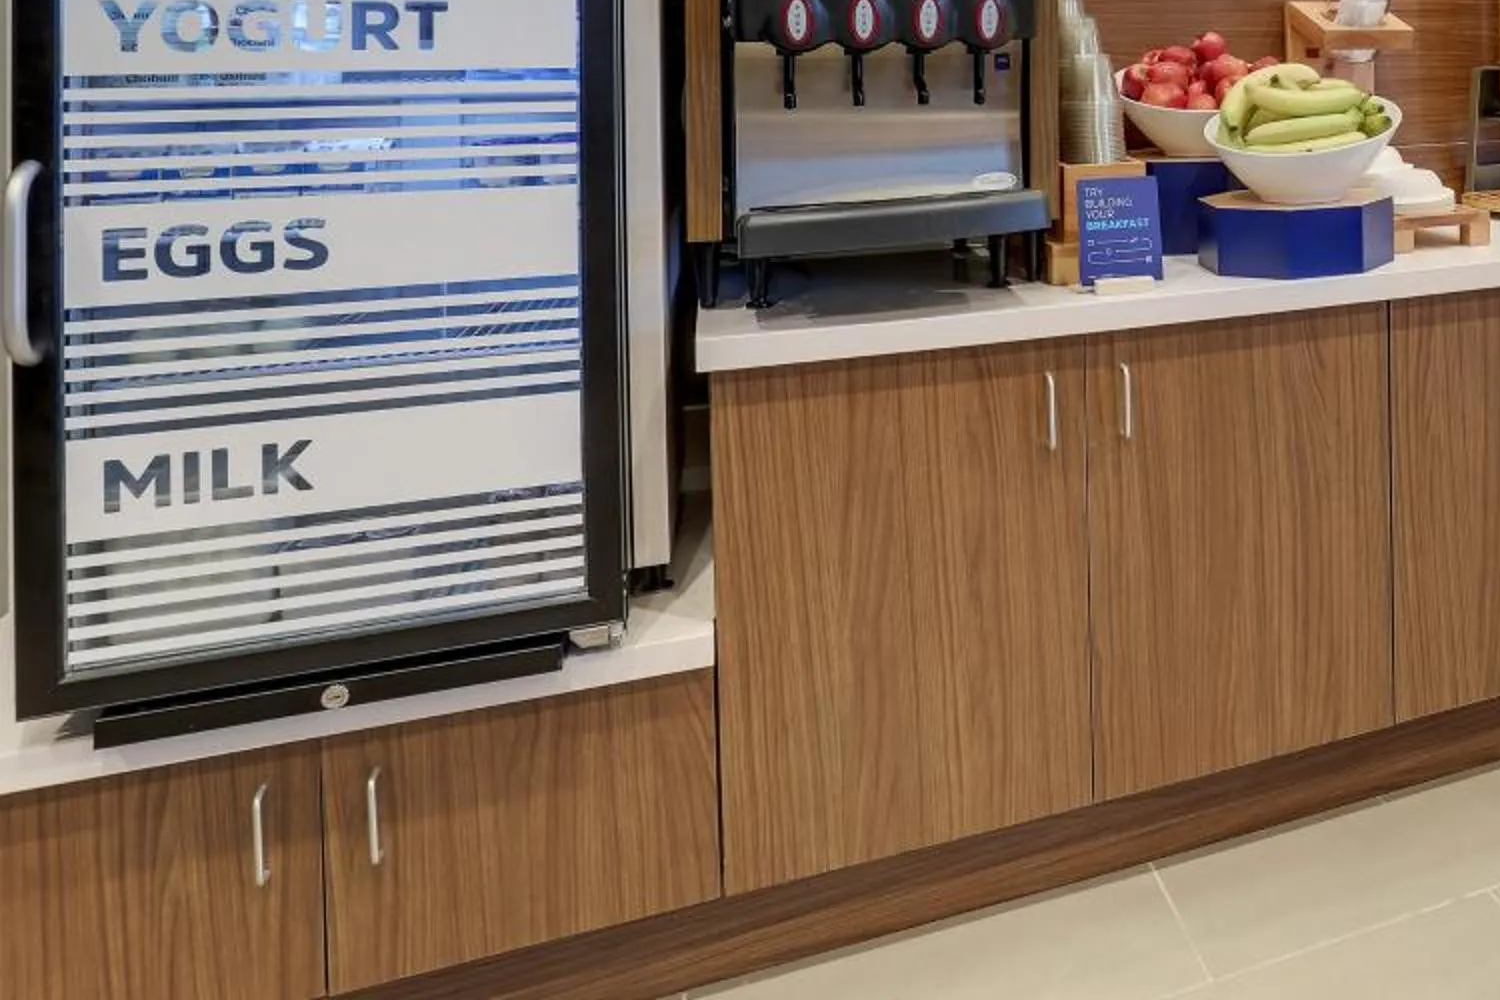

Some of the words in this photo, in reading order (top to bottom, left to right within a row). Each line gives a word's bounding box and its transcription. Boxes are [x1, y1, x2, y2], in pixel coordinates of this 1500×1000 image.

[99, 0, 449, 53] YOGURT
[1085, 187, 1104, 198] TRY
[1085, 198, 1133, 209] BUILDING
[1085, 209, 1115, 220] YOUR
[1086, 217, 1150, 231] BREAKFAST
[101, 217, 330, 282] EGGS
[103, 438, 315, 514] MILK
